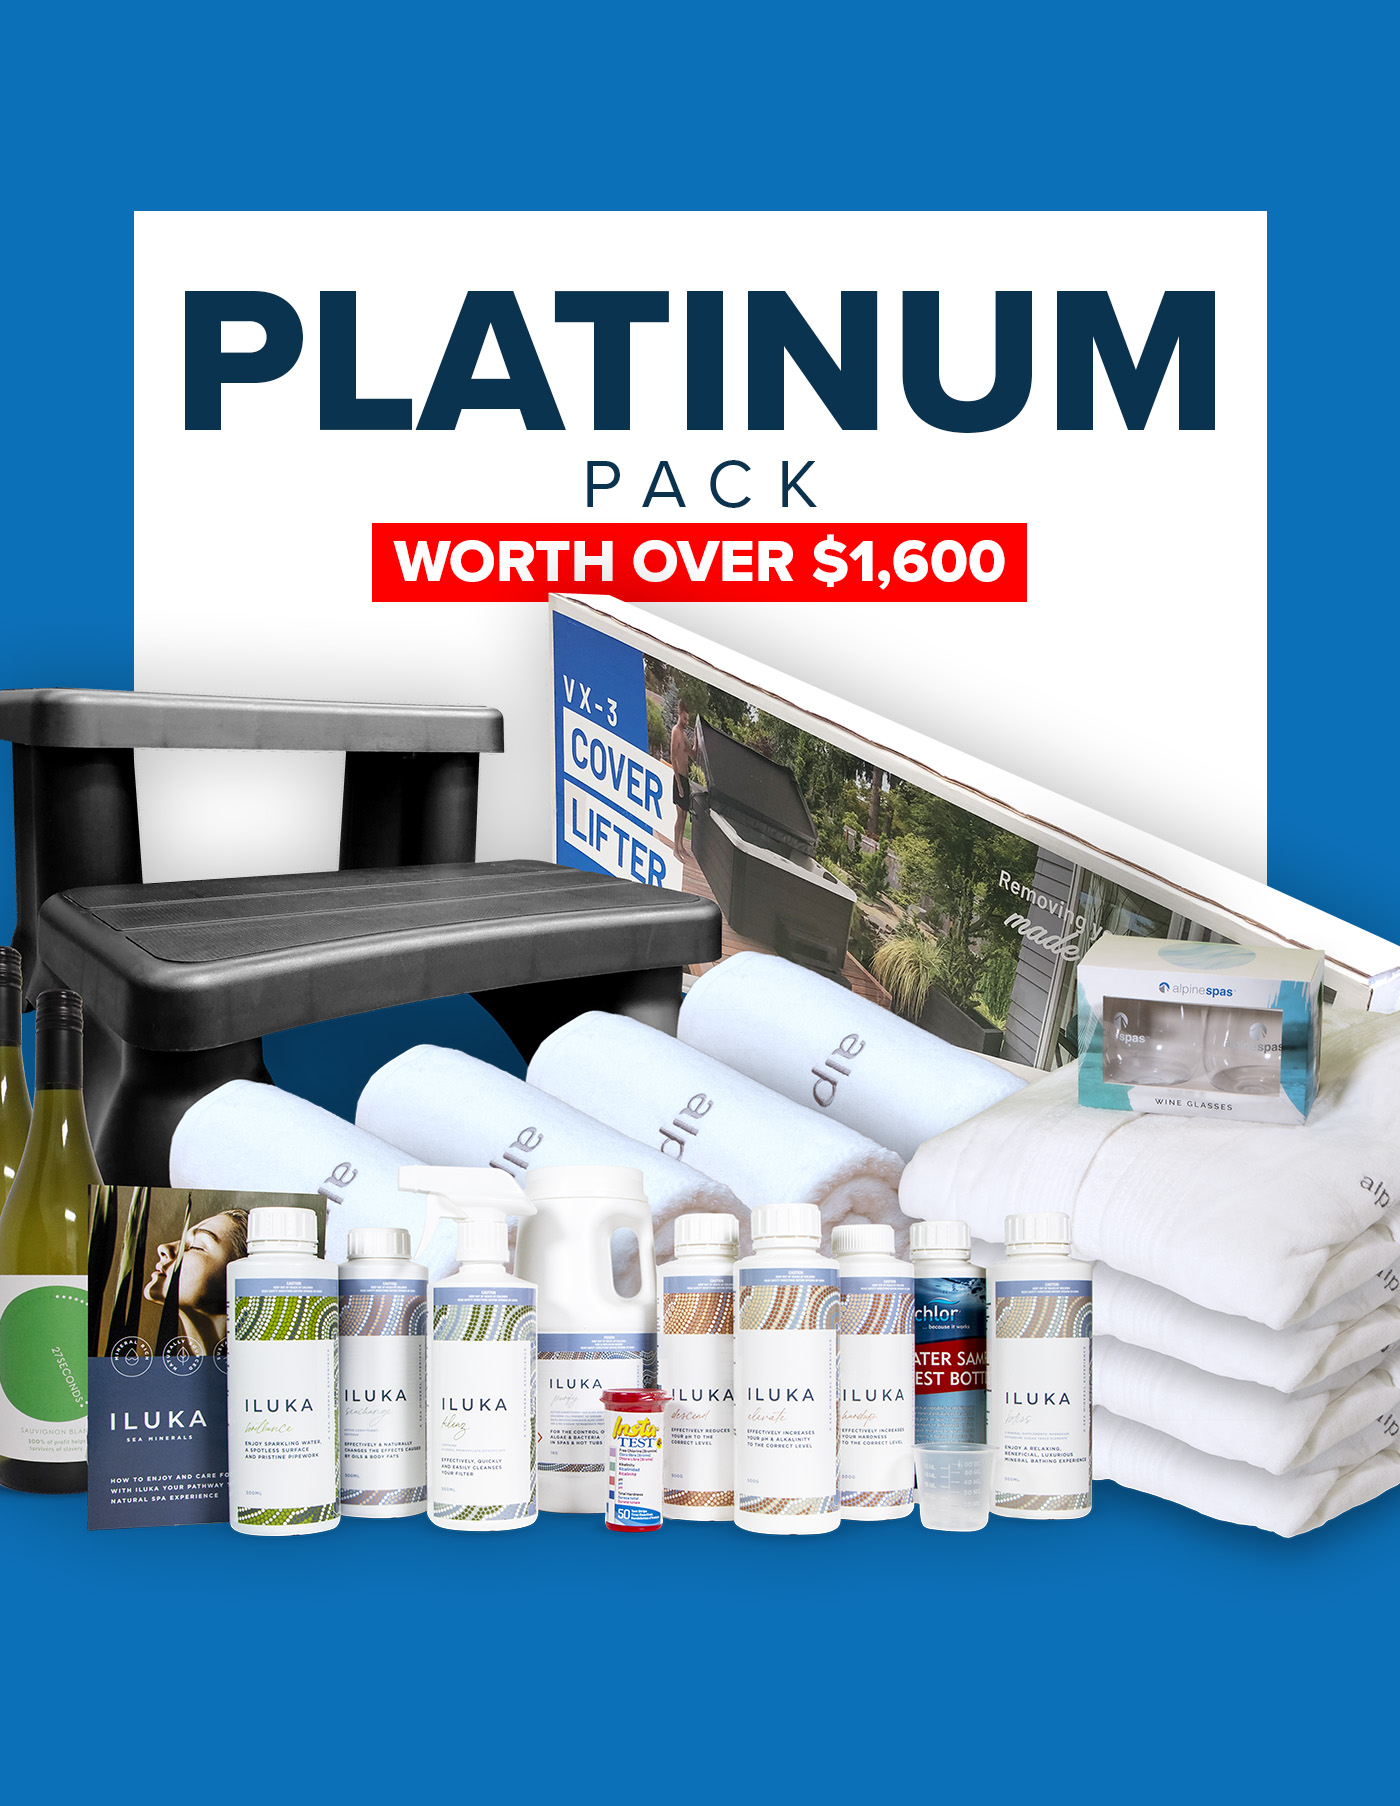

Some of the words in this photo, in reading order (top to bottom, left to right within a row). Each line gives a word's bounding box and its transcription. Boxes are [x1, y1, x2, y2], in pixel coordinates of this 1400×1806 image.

[562, 674, 619, 727] VX-3
[571, 726, 663, 820] COVER
[571, 796, 666, 886] LIFTER
[998, 869, 1087, 934] Removing
[1003, 912, 1081, 961] made
[1172, 983, 1233, 998] alpinespas
[1155, 1098, 1181, 1106] WINE
[1187, 1101, 1233, 1111] GLASSES
[114, 1340, 138, 1361] MINERAL
[51, 1346, 84, 1403] 27SECONDS
[950, 1371, 987, 1386] BOTT
[549, 1378, 602, 1390] ILUKA
[345, 1389, 407, 1402] ILUKA
[672, 1388, 734, 1401] ILUKA
[748, 1387, 814, 1401] ILUKA
[843, 1389, 904, 1401] ILUKA
[1005, 1392, 1070, 1405] ILUKA
[245, 1398, 314, 1413] ILUKA
[442, 1397, 507, 1411] ILUKA
[110, 1410, 207, 1431] ILUKA
[21, 1427, 66, 1435] SAUVIGNON
[618, 1437, 655, 1448] TEST
[187, 1482, 224, 1490] PATHWAY
[110, 1496, 148, 1505] NATURAL
[169, 1492, 219, 1501] EXPERIENCE
[618, 1508, 630, 1520] 50
